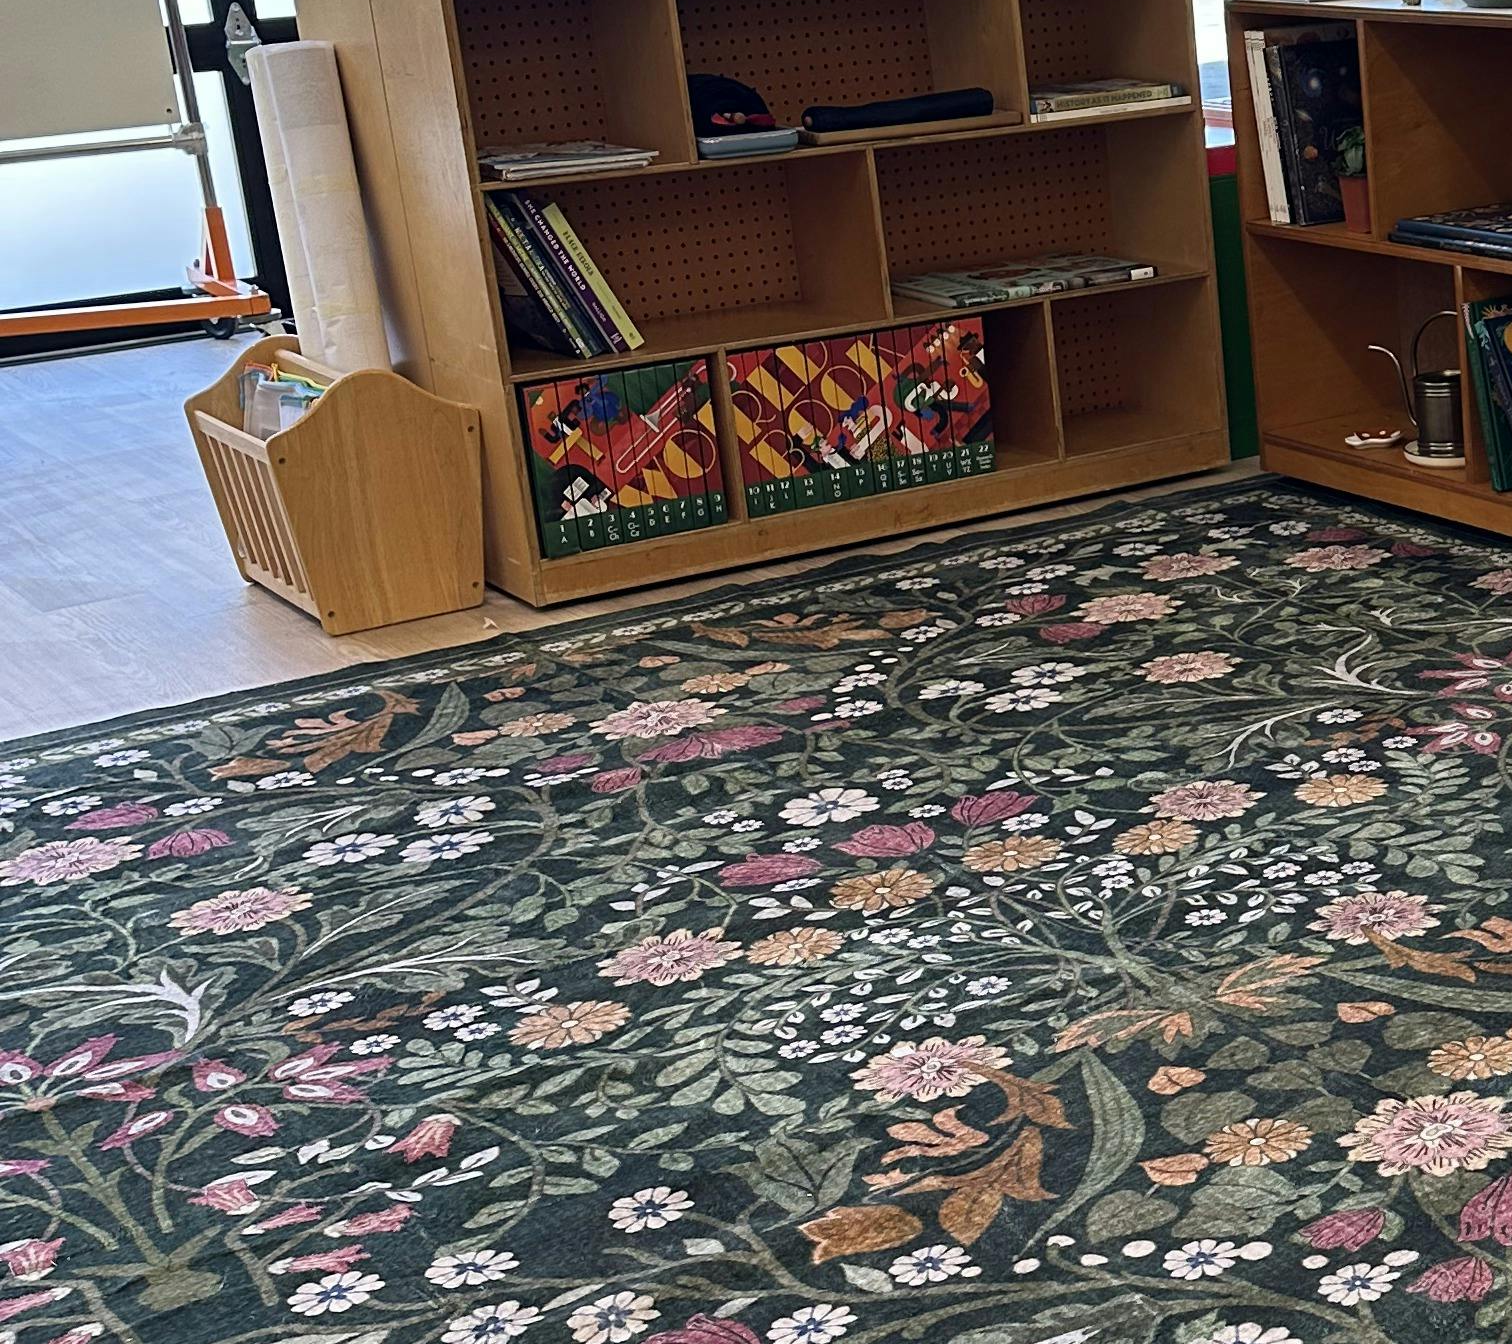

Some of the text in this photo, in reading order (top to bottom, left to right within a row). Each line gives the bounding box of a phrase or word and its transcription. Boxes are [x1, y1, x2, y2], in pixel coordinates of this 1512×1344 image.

[1054, 96, 1090, 109] HISTORY
[1091, 96, 1101, 105] AS
[1111, 89, 1153, 102] HAPPENED
[534, 214, 559, 250] CHANGED
[557, 249, 569, 265] THE
[567, 264, 586, 291] WORLD
[830, 472, 840, 480] 14
[780, 481, 790, 489] 12
[803, 478, 814, 486] 13
[858, 478, 864, 486] P
[749, 487, 760, 495] 10
[609, 514, 615, 522] 3
[629, 511, 635, 519] 4
[587, 519, 594, 527] 2
[561, 535, 568, 544] A
